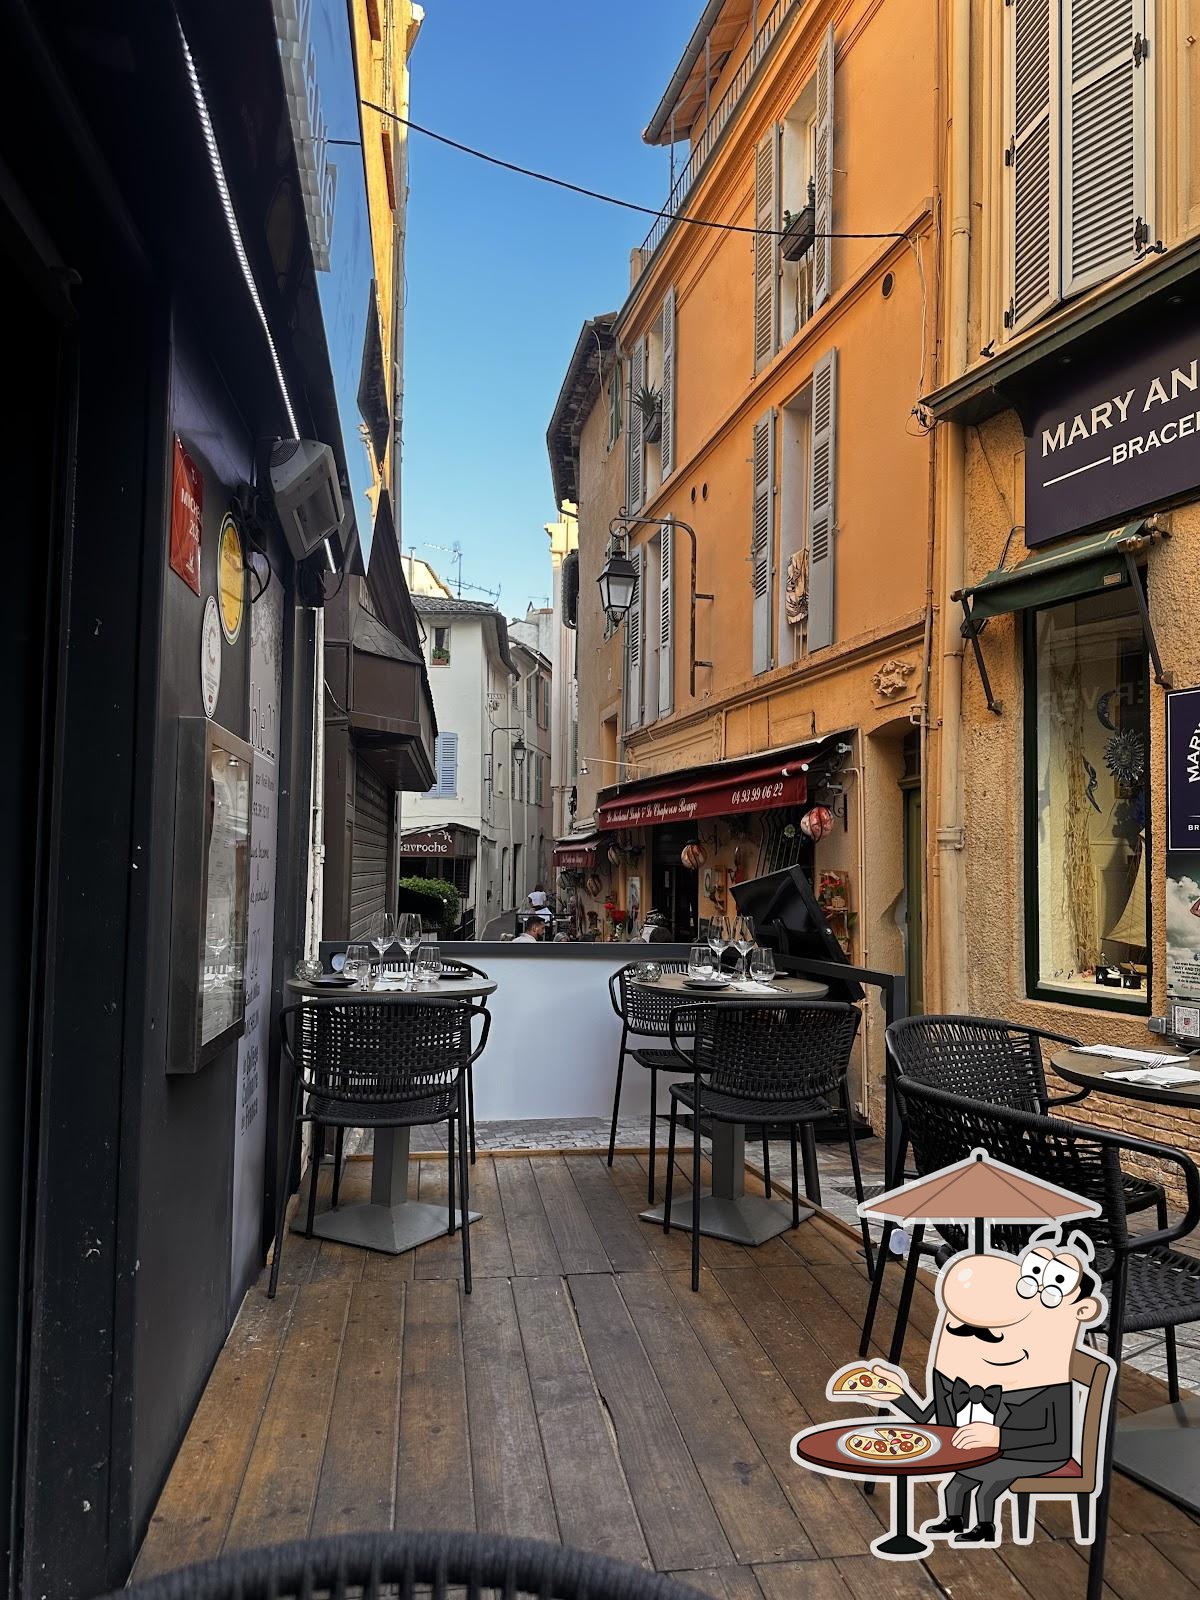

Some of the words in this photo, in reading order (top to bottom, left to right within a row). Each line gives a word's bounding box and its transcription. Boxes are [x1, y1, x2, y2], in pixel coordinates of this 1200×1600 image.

[1041, 388, 1136, 458] MARY
[731, 790, 741, 805] 04
[740, 789, 751, 803] 93
[750, 787, 761, 802] 99
[761, 784, 773, 800] 06
[772, 782, 784, 797] 22
